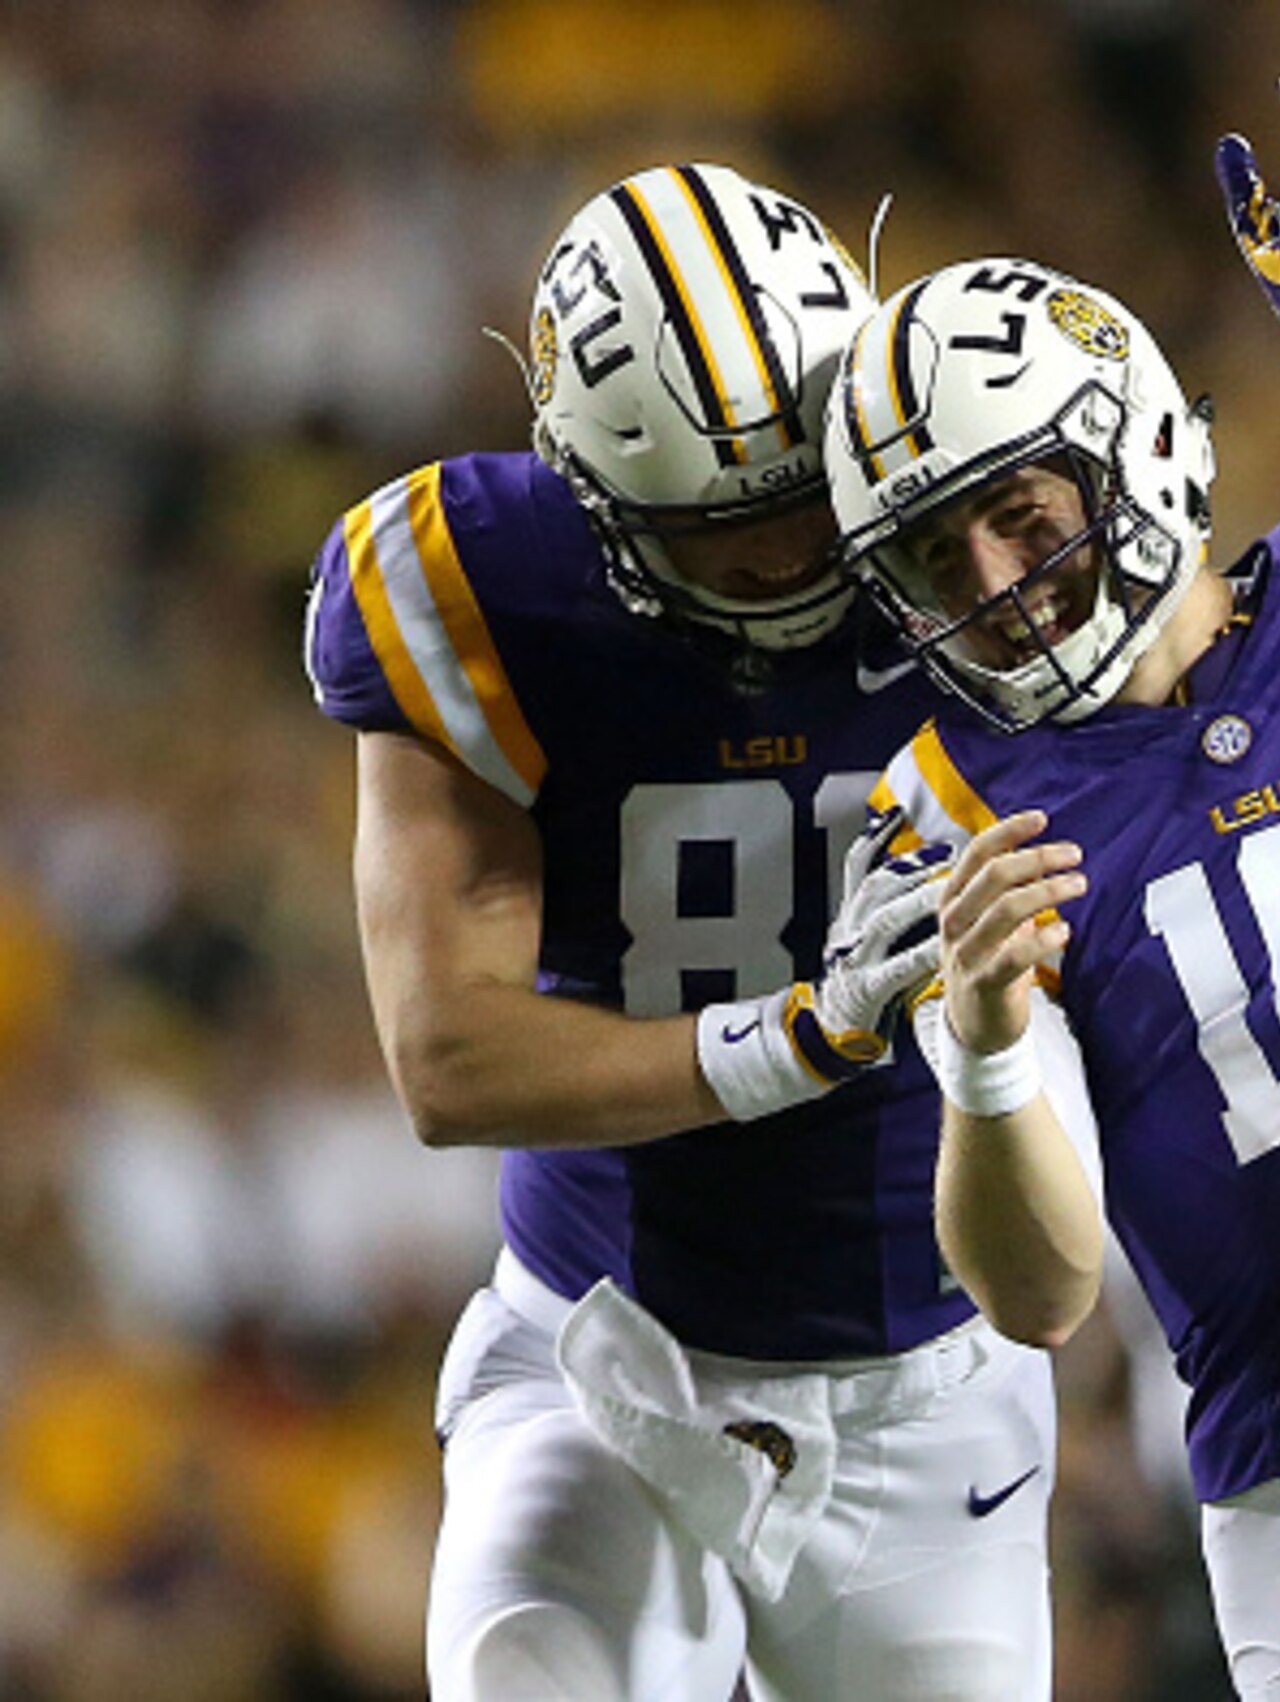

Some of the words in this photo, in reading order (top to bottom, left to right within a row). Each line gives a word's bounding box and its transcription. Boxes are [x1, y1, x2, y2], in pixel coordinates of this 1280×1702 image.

[748, 194, 850, 311] LS
[947, 261, 1049, 356] LS
[877, 464, 932, 509] LSU
[719, 736, 808, 768] LSU
